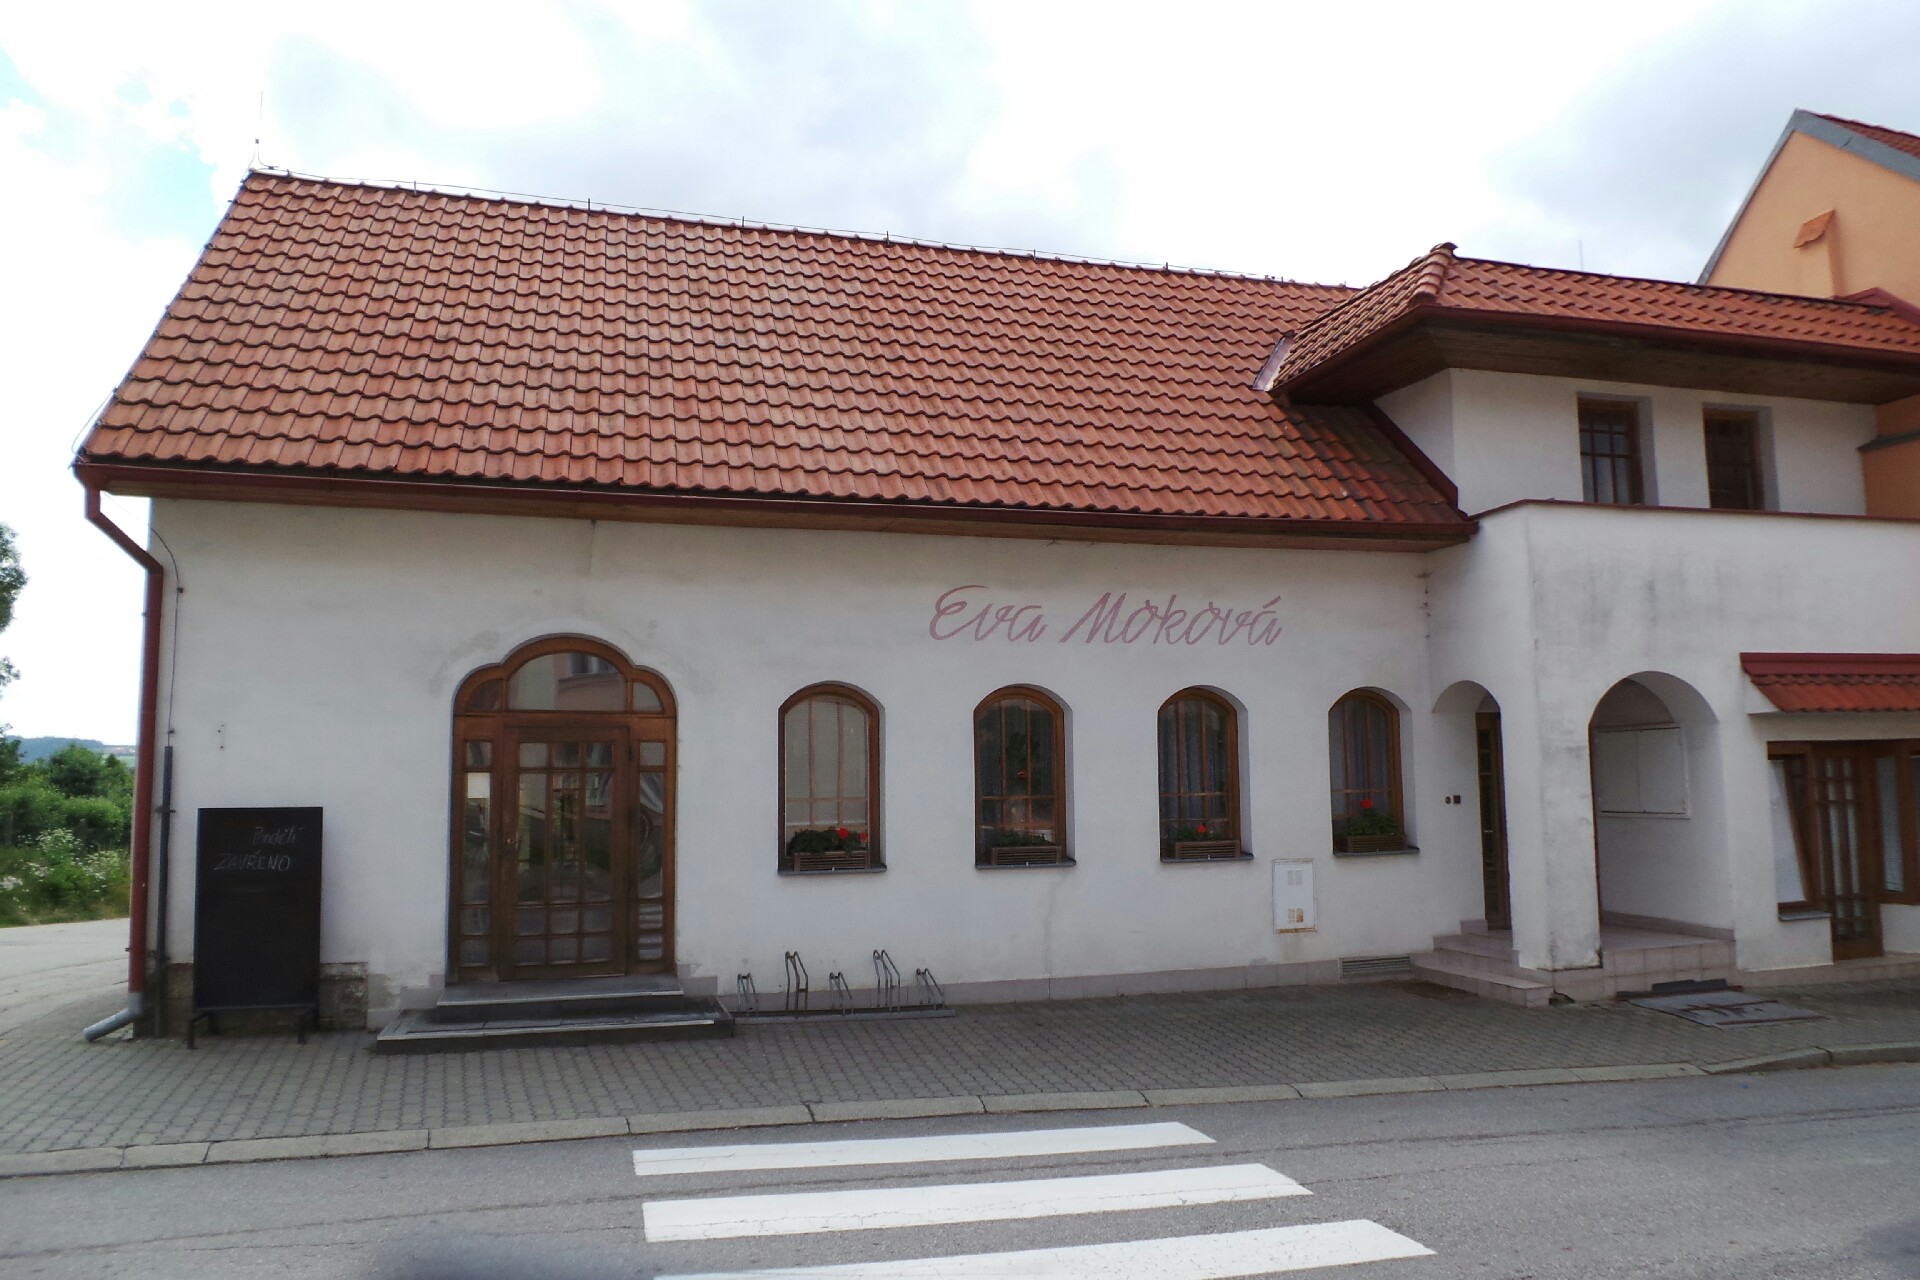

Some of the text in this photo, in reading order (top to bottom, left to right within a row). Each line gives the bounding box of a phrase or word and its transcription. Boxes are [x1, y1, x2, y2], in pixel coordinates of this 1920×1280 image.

[928, 584, 1284, 646] Eva Moková
[213, 849, 291, 872] ZAVŘENO
